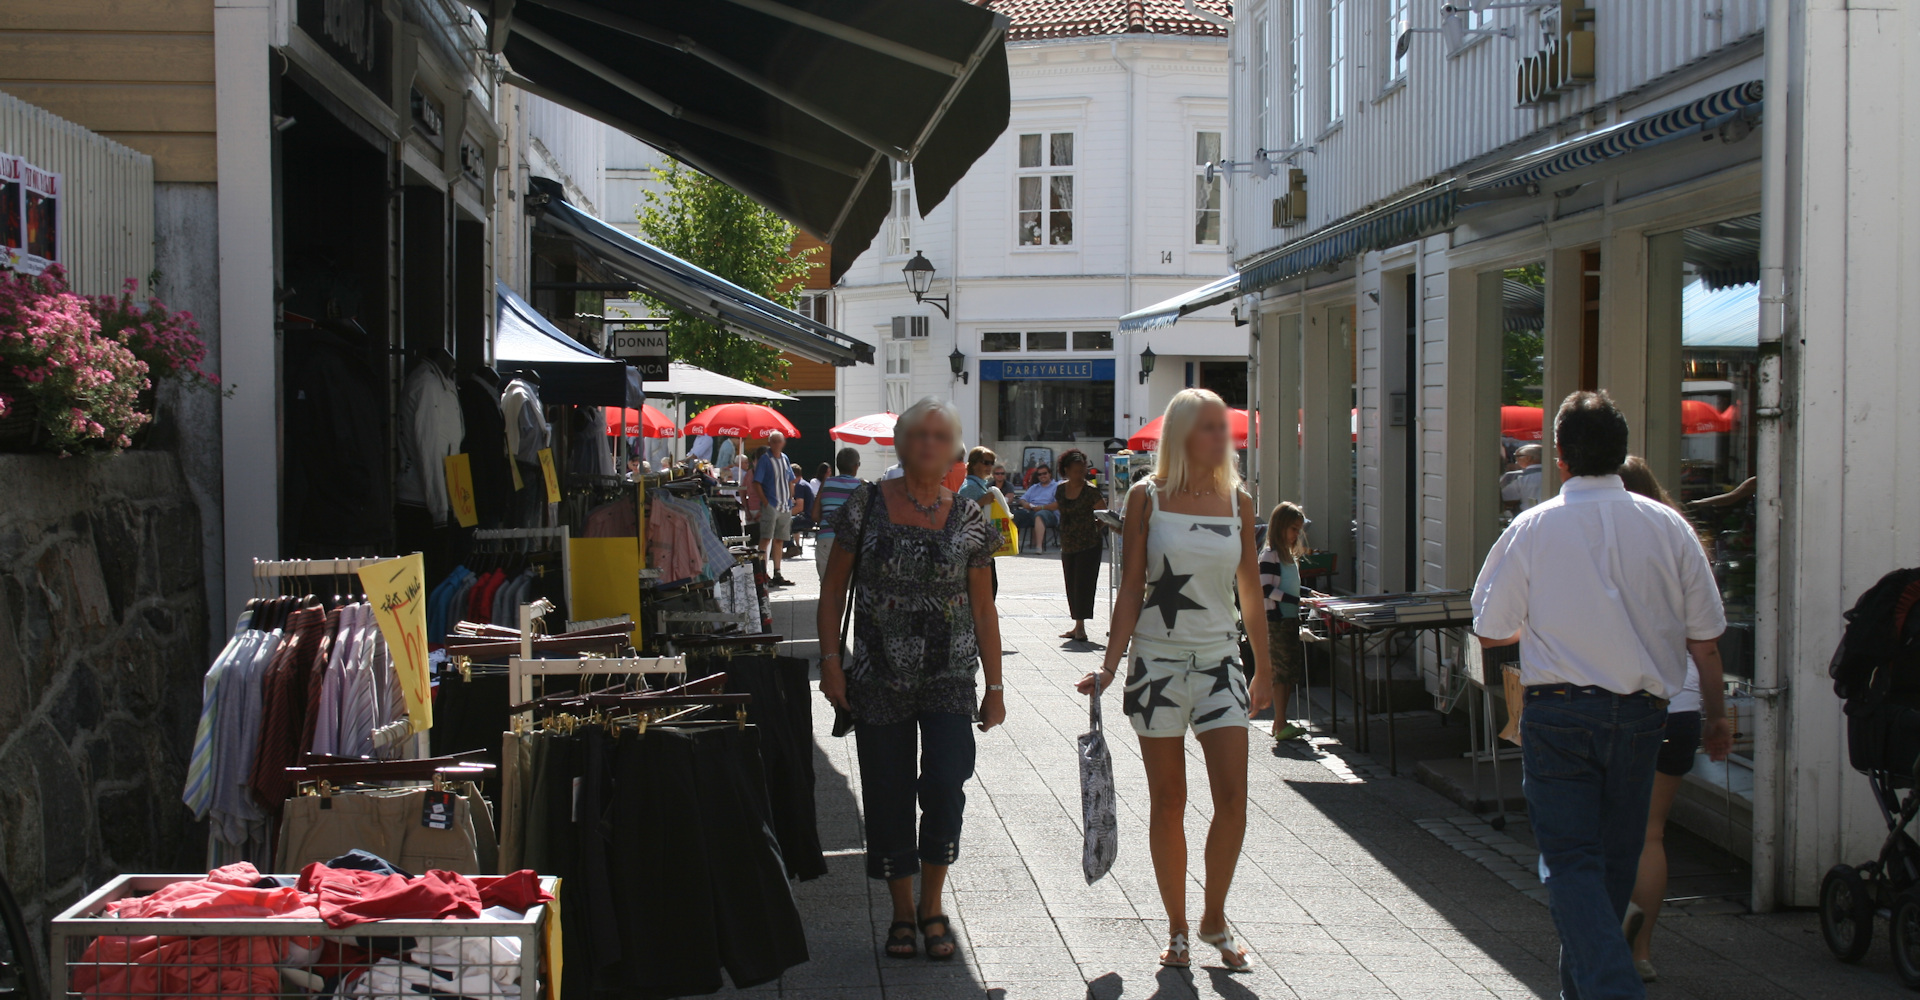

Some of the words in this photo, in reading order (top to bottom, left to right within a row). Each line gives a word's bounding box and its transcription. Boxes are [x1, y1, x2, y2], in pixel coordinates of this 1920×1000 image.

[1514, 0, 1575, 108] norli
[1161, 250, 1172, 264] 14
[618, 337, 664, 348] DONNA
[637, 364, 663, 374] NCA
[1006, 364, 1088, 375] PARFYMELLE
